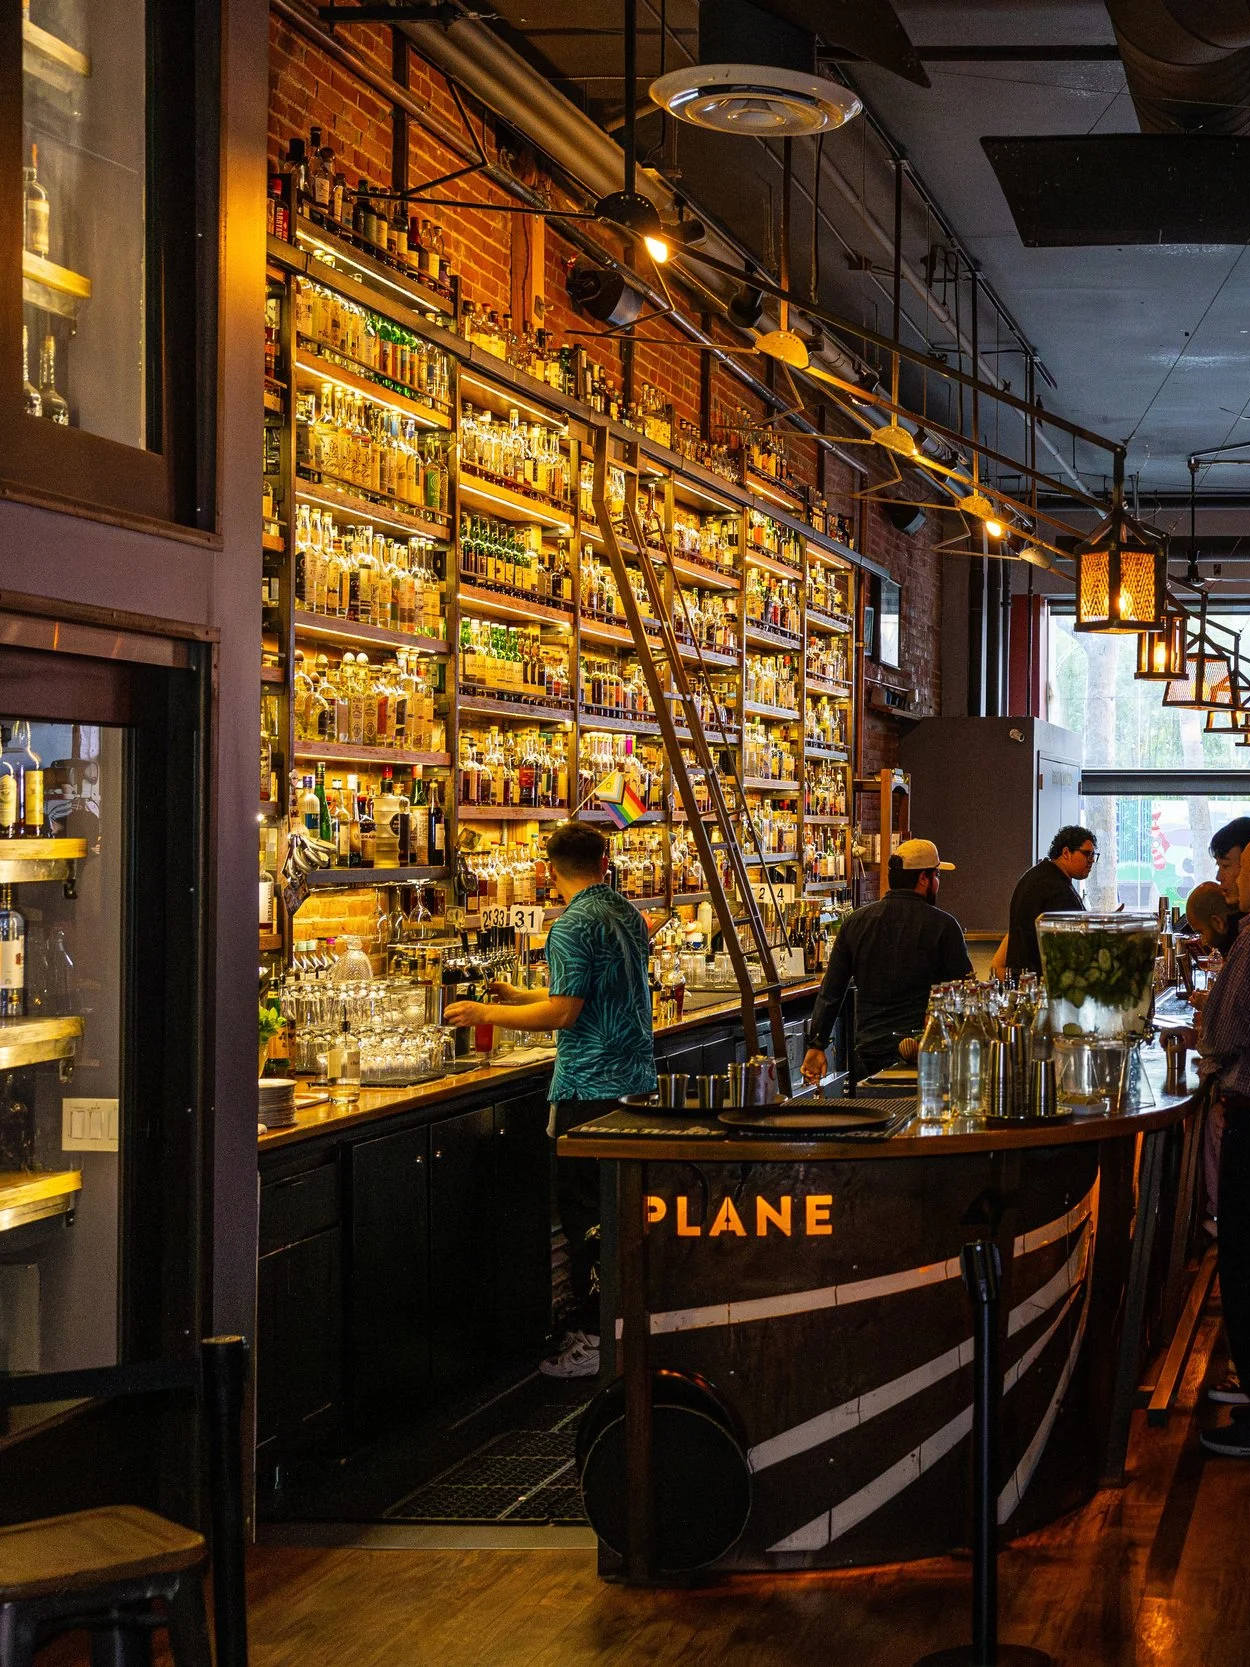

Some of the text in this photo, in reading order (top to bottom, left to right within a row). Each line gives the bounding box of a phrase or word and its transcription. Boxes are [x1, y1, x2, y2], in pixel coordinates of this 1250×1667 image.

[493, 908, 505, 927] 33
[514, 910, 535, 929] 31
[645, 1194, 833, 1237] PLANE
